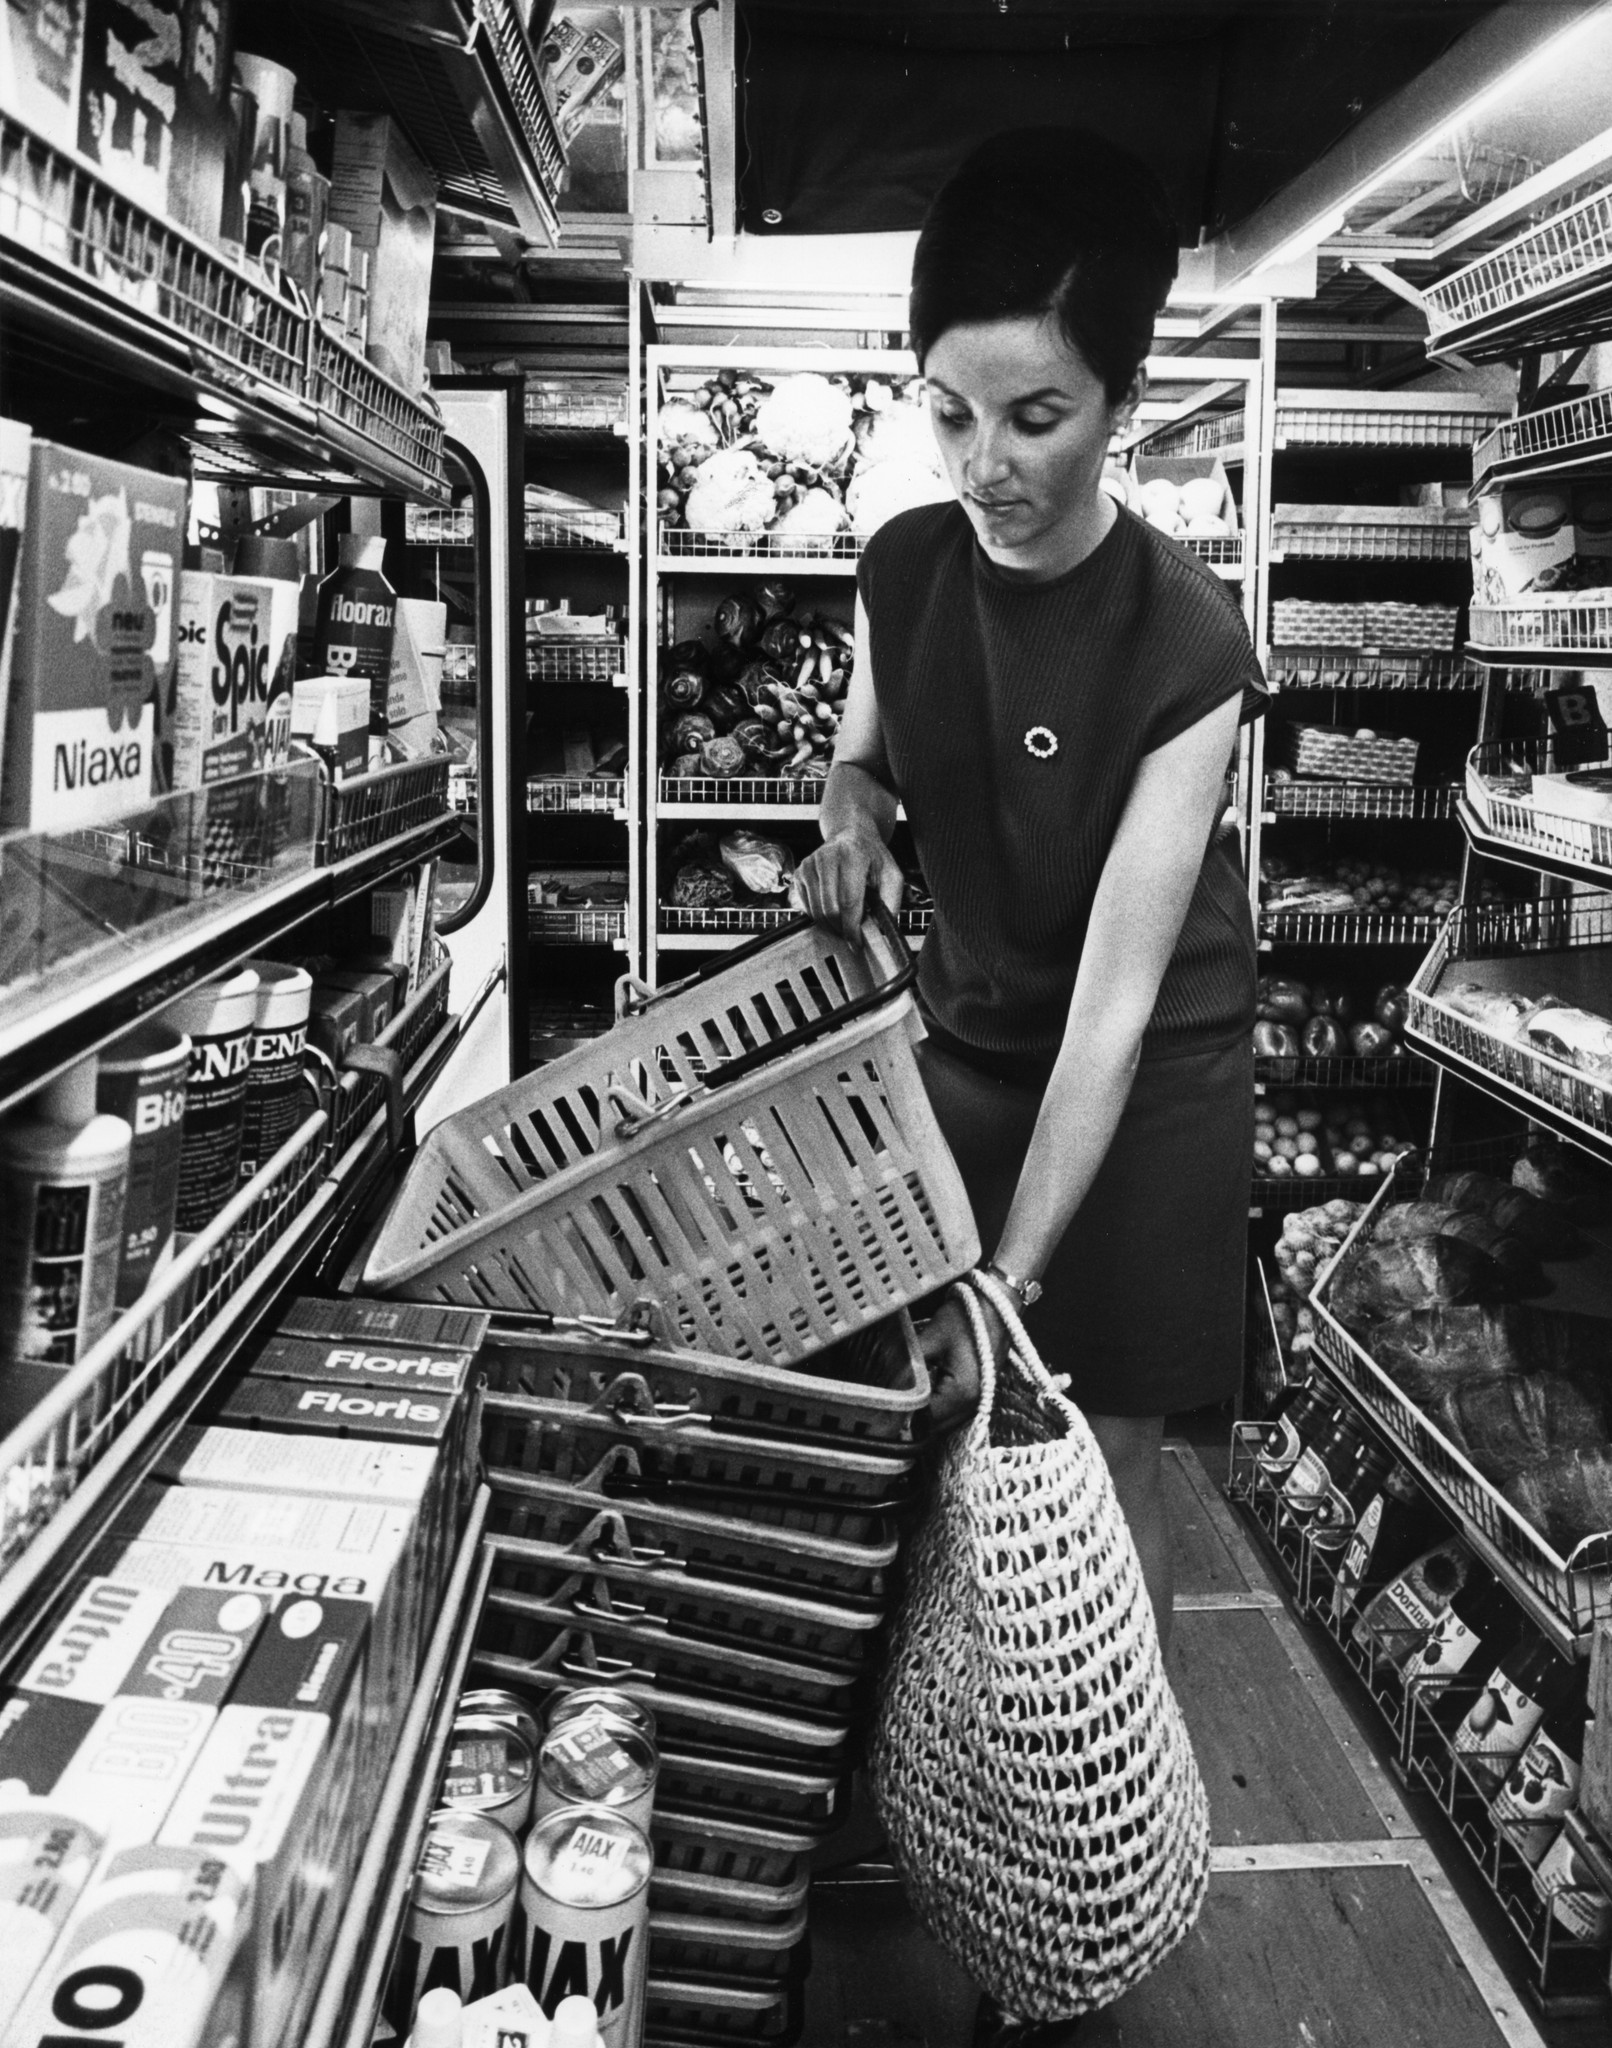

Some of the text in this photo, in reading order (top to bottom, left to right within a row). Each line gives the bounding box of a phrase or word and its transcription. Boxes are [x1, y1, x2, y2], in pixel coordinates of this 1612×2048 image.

[331, 594, 393, 627] floorax
[212, 601, 269, 733] Spic
[54, 739, 141, 791] Niaxa
[135, 1091, 185, 1134] Bio
[326, 1351, 459, 1377] Floris
[298, 1391, 440, 1422] Floris
[205, 1562, 367, 1596] Maga
[1391, 1583, 1431, 1629] Dorina
[36, 1585, 139, 1689] Ultra
[195, 1715, 294, 1847] Ultra
[573, 1833, 615, 1860] AJAX
